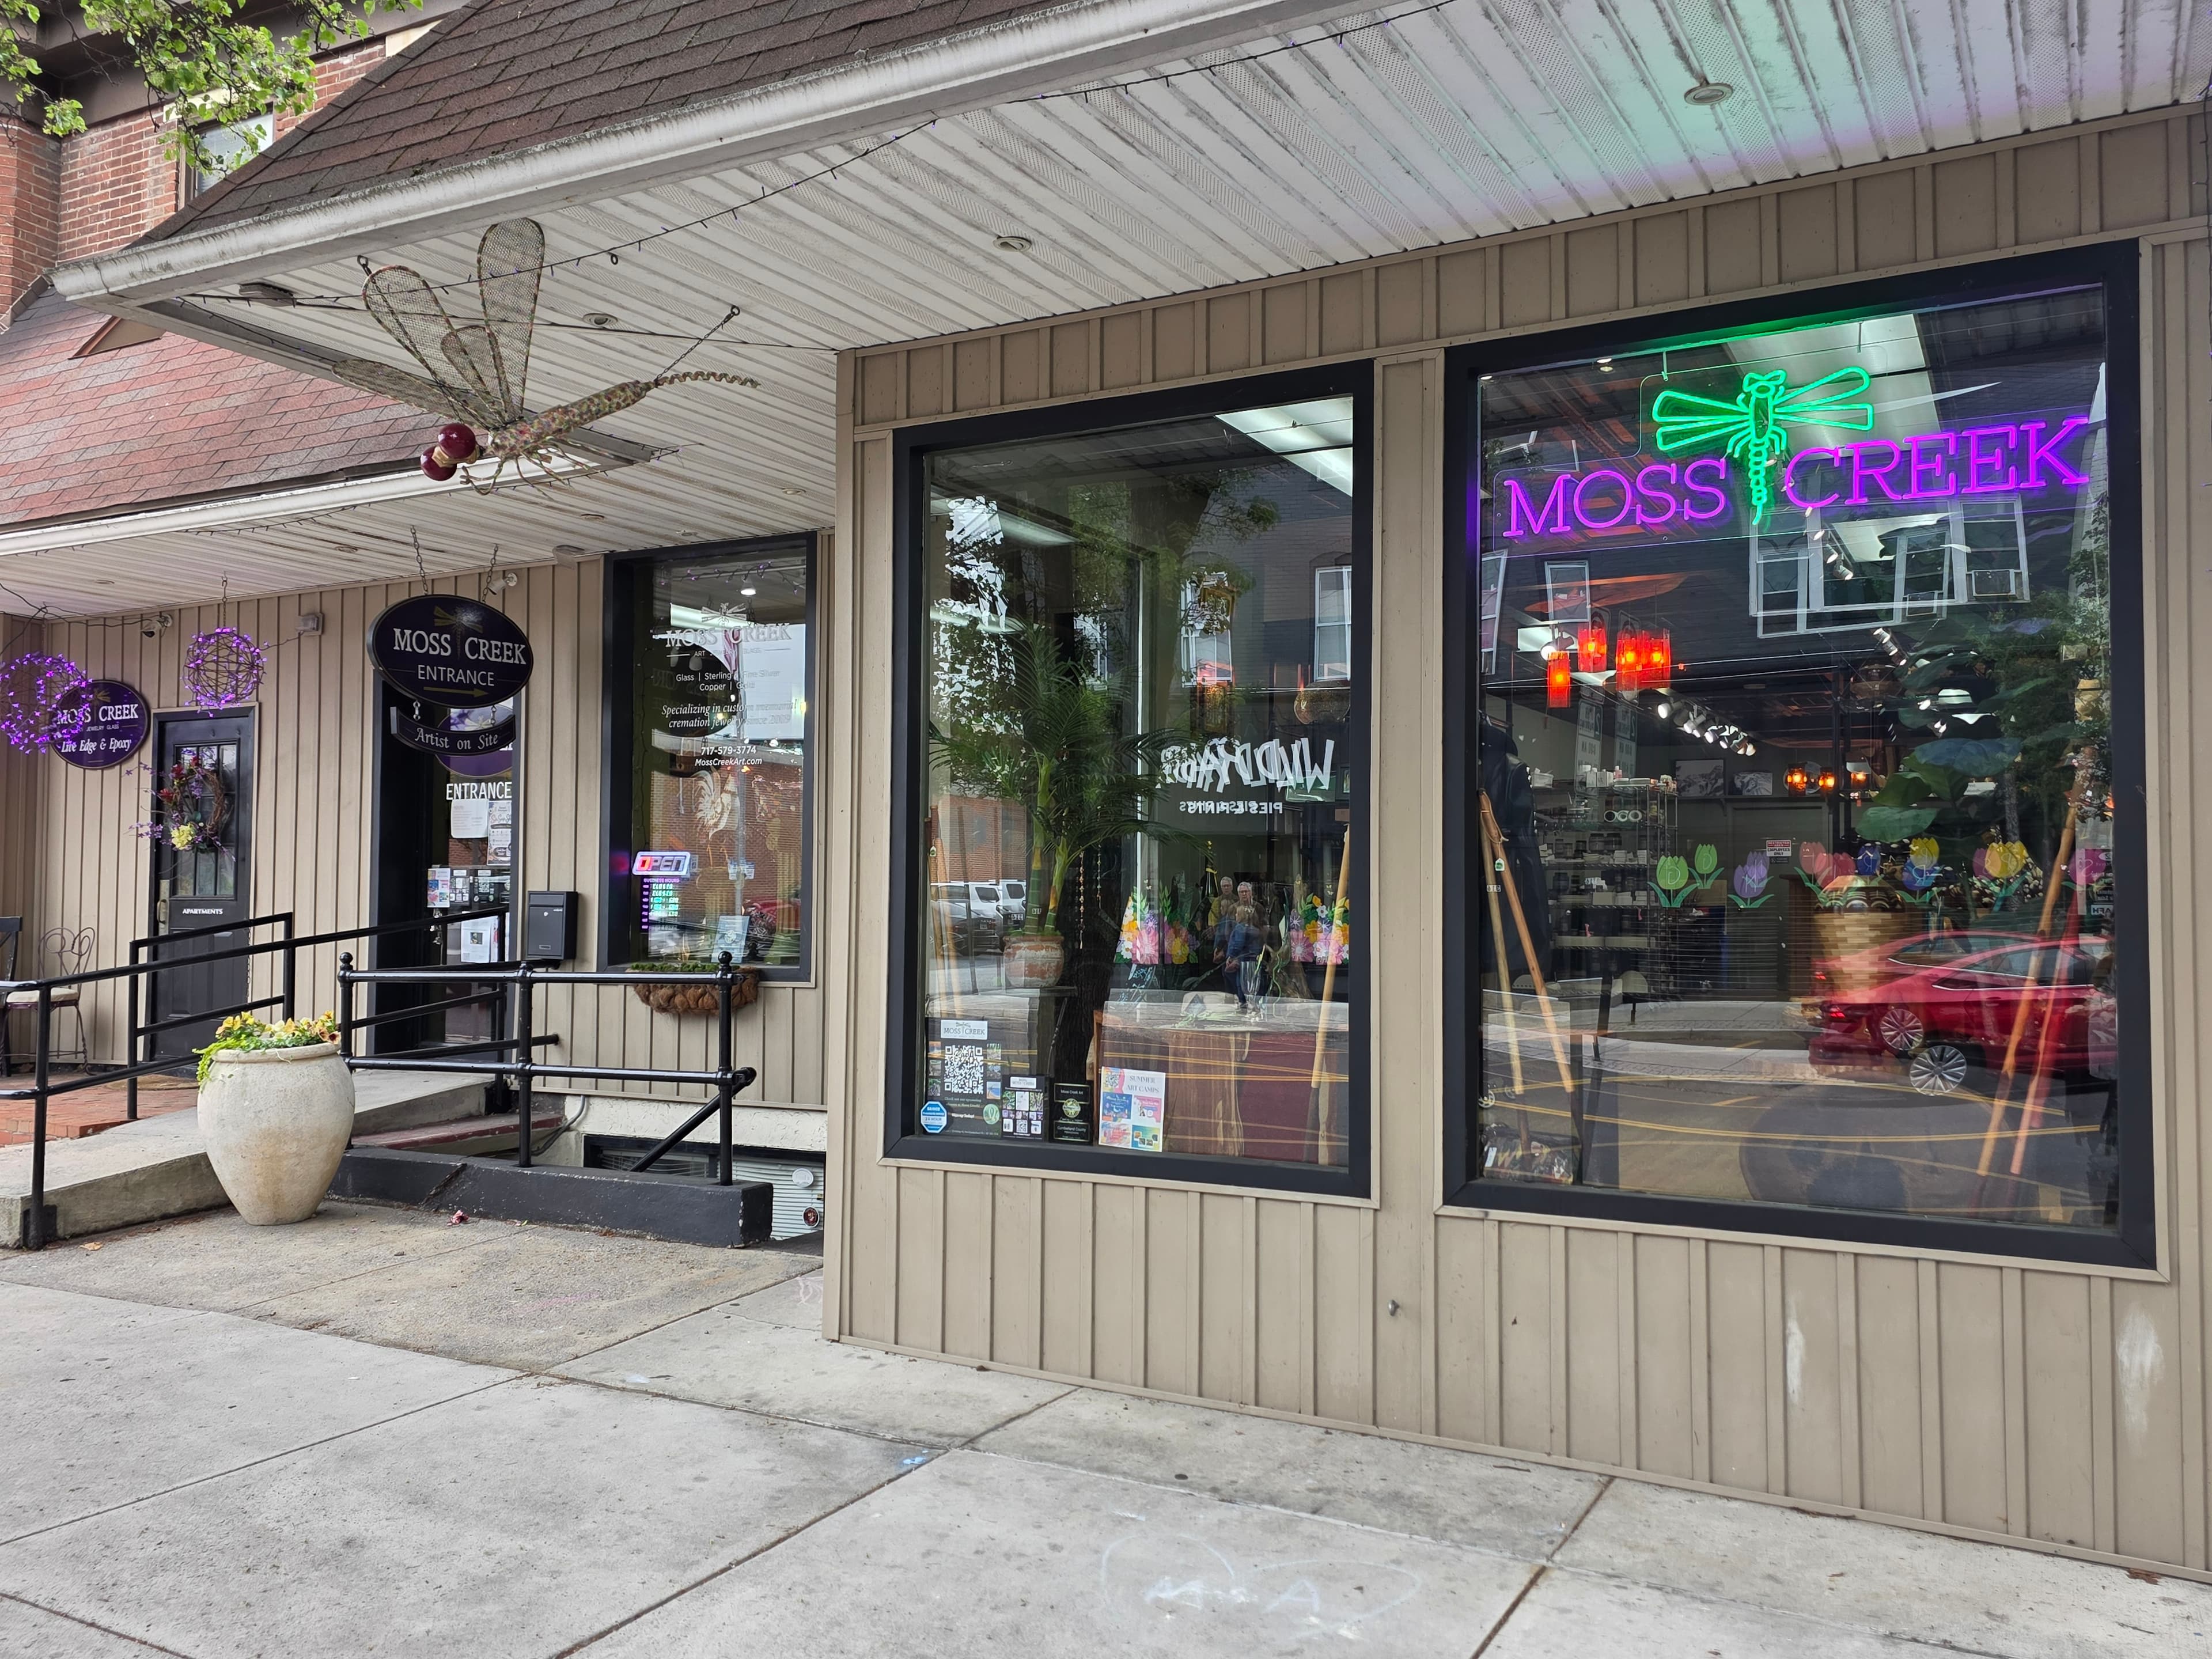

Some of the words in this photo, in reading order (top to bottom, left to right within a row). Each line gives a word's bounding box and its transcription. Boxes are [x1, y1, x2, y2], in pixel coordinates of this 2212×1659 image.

[1501, 459, 1727, 538] MOSS
[1783, 416, 2091, 509] CREEK
[665, 628, 718, 647] MOSS
[730, 622, 792, 644] CREEK
[393, 628, 451, 656] MOSS
[464, 637, 527, 665] CREEK
[418, 665, 494, 686] ENTRANCE
[676, 673, 695, 681] Glass
[704, 671, 732, 681] Sterling
[699, 683, 726, 692] Copper
[99, 704, 139, 721] CREEK
[661, 703, 710, 717] Specializing
[712, 703, 721, 713] in
[668, 718, 710, 728] cremation
[79, 738, 97, 754] Edge
[100, 738, 106, 749] &
[109, 737, 131, 752] Epoxy
[415, 728, 449, 748] Artist
[457, 740, 471, 749] on
[478, 733, 498, 748] Site
[701, 745, 756, 755] 717-579-3774
[695, 757, 762, 766] MossCreekArt.com
[446, 781, 512, 800] ENTRANCE
[637, 856, 685, 872] OPEN
[1129, 1075, 1155, 1084] SUMMER
